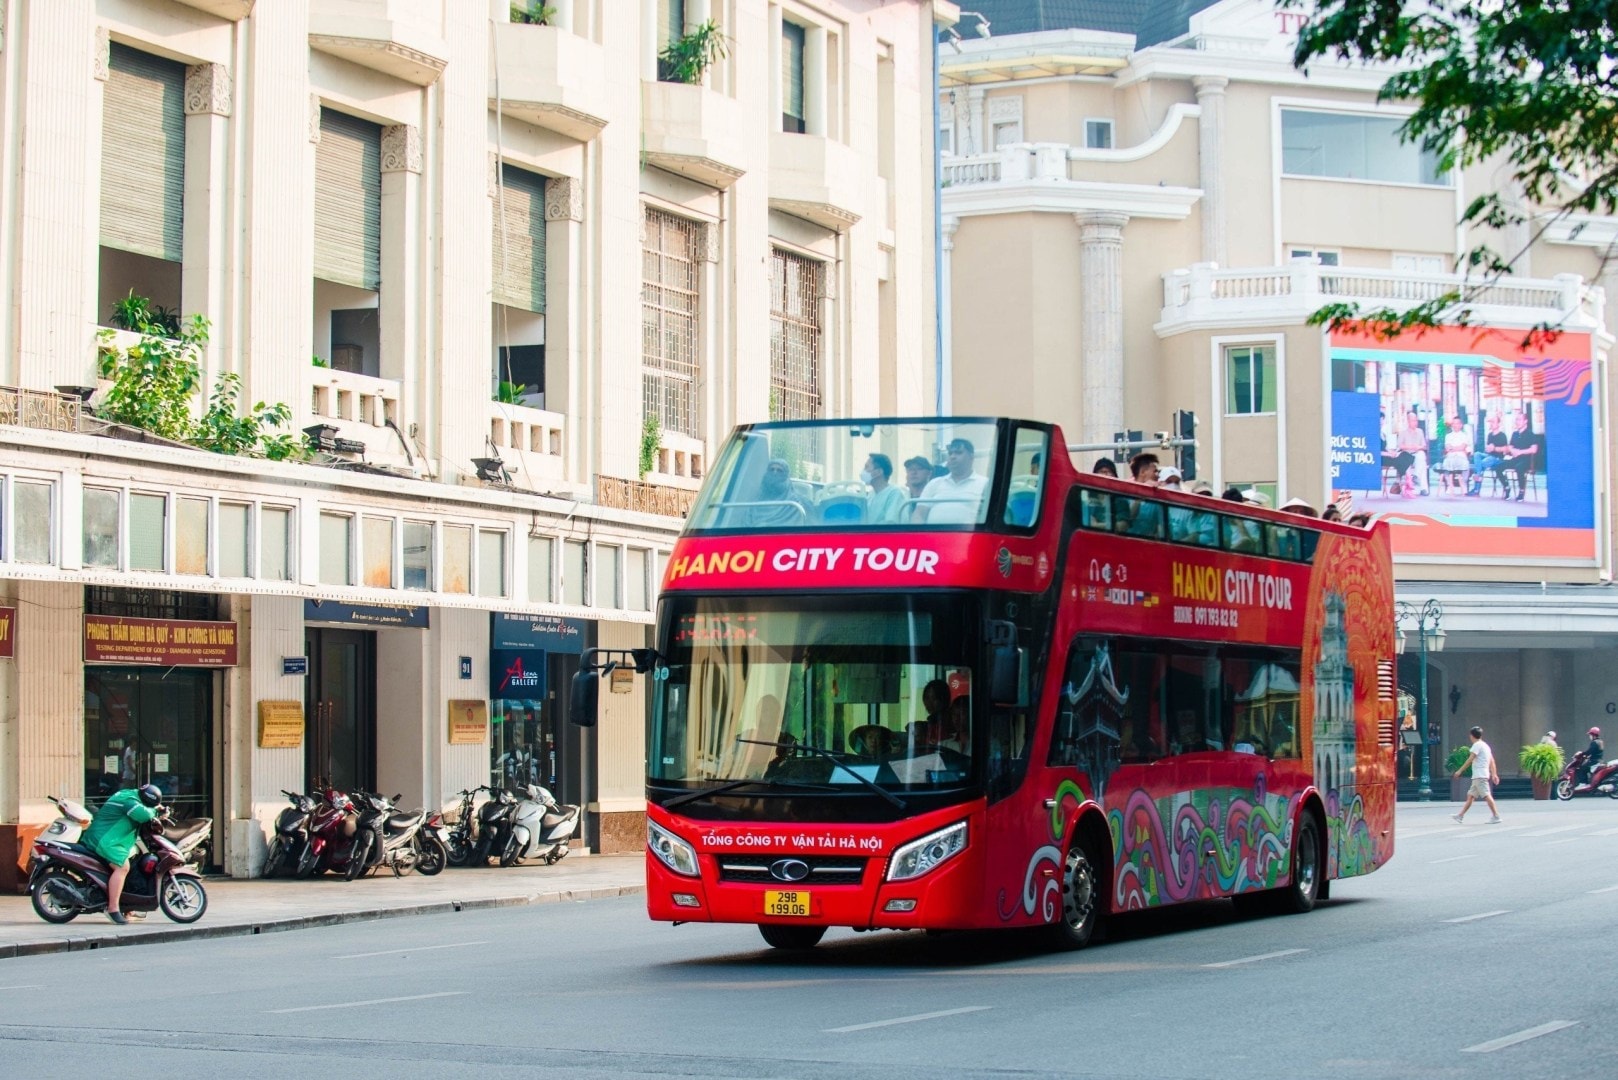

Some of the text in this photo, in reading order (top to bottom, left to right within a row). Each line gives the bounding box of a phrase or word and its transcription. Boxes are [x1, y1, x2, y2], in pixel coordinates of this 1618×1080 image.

[670, 548, 939, 582] HANOI CITY TOUR
[1173, 561, 1292, 610] HANOI CITY TOUR
[463, 662, 470, 673] 91
[1606, 702, 1616, 714] G
[702, 830, 882, 852] TỔNG CÔNG TY VẬN TẢI HÀ NỘI
[778, 892, 797, 903] 29B
[771, 904, 805, 915] 199.06
